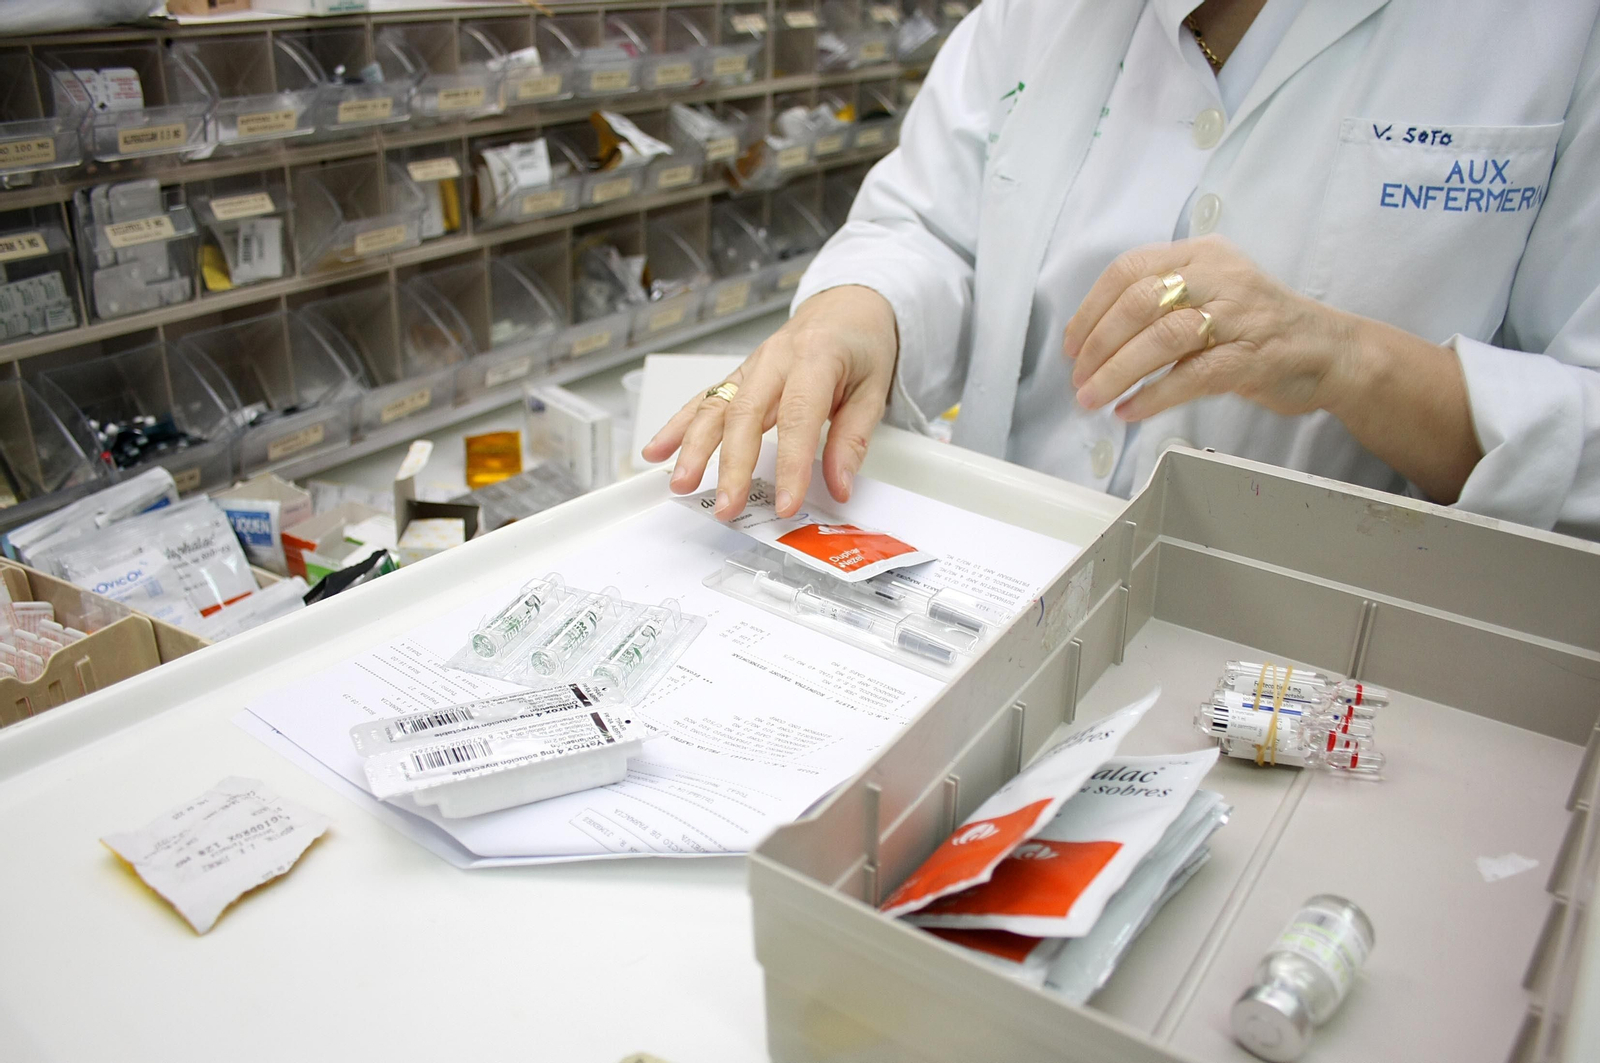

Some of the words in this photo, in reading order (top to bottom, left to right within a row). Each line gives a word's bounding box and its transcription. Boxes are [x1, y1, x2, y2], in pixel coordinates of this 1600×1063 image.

[1373, 124, 1392, 141] V.
[14, 143, 32, 153] 100
[36, 141, 50, 150] MG
[538, 748, 555, 757] mg
[555, 747, 564, 755] 4
[1094, 784, 1173, 798] sobres
[613, 808, 647, 830] FARMACIA
[582, 816, 613, 837] JIMENEZ
[648, 829, 662, 839] DE
